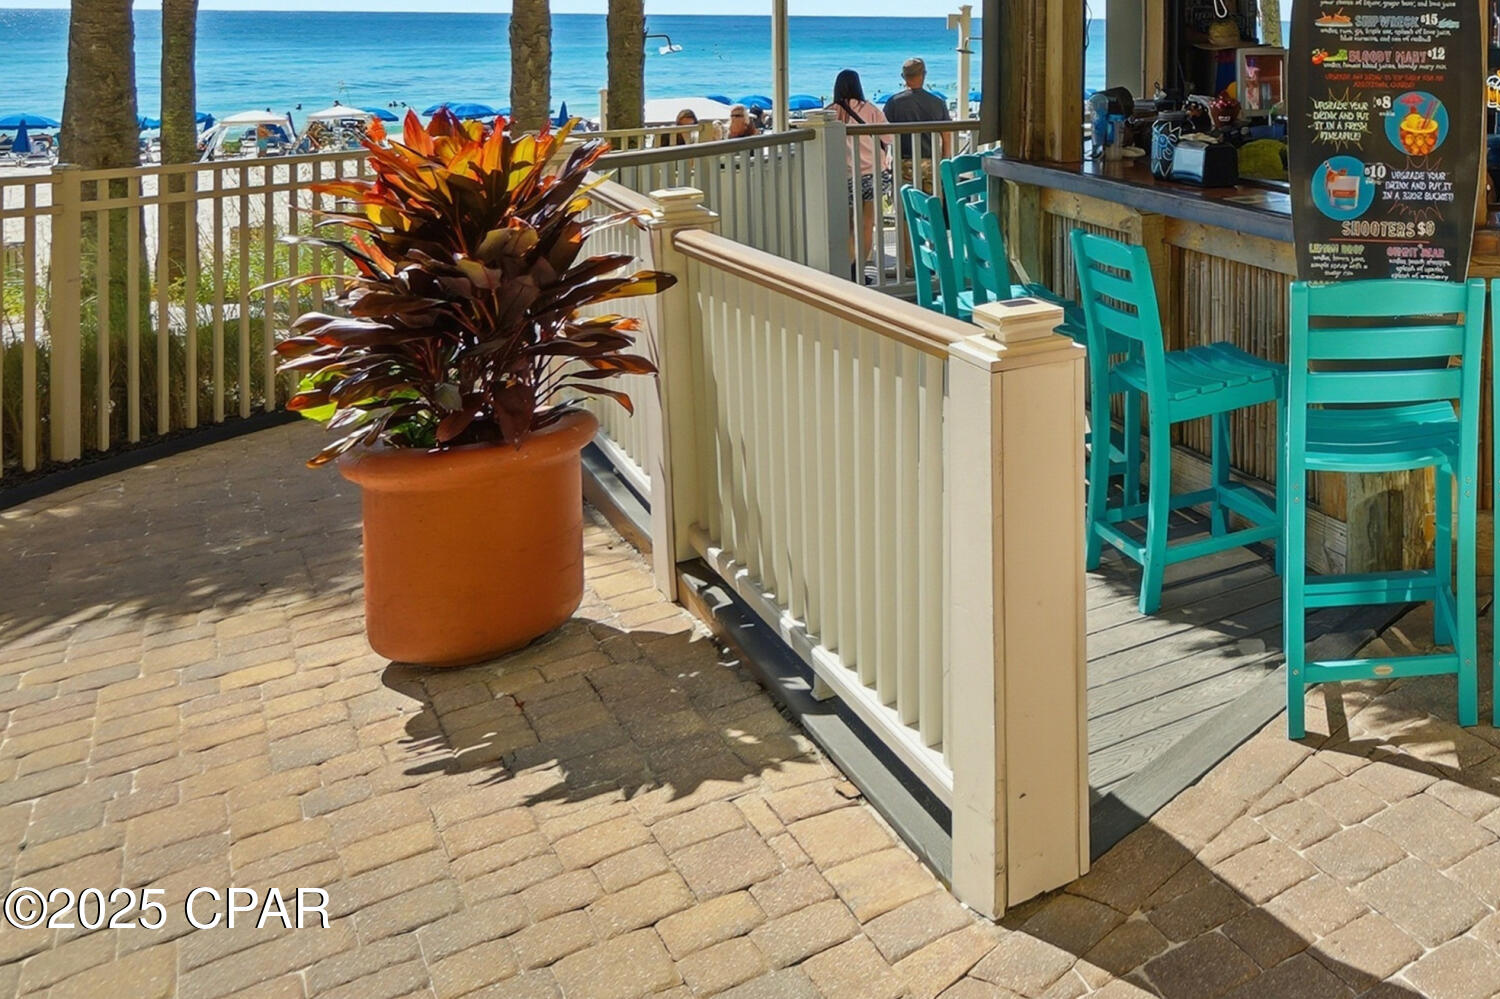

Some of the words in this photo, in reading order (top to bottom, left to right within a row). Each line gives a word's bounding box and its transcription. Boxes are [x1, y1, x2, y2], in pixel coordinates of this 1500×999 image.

[1354, 15, 1419, 28] SHIPWRECK
[1420, 13, 1439, 26] $15
[1348, 50, 1393, 64] BLOODY
[1394, 50, 1427, 64] MARY
[1427, 47, 1446, 61] $12
[1313, 101, 1348, 110] UPGRADE
[1349, 101, 1369, 110] YOUR
[1313, 111, 1339, 120] DRINK
[1339, 111, 1355, 120] AND
[1356, 111, 1370, 121] PUT
[1325, 121, 1336, 131] IN
[1337, 121, 1344, 131] A
[1344, 121, 1369, 131] FRESH
[1364, 164, 1387, 179] $10
[1390, 170, 1425, 181] UPGRADE
[1427, 171, 1447, 181] YOUR
[1385, 181, 1409, 191] DRINK
[1410, 181, 1427, 190] AND
[1382, 191, 1393, 200] IN
[1394, 191, 1401, 200] A
[1341, 220, 1416, 238] SHOOTERS
[1308, 243, 1340, 254] LEMON
[1420, 247, 1446, 258] BEAR
